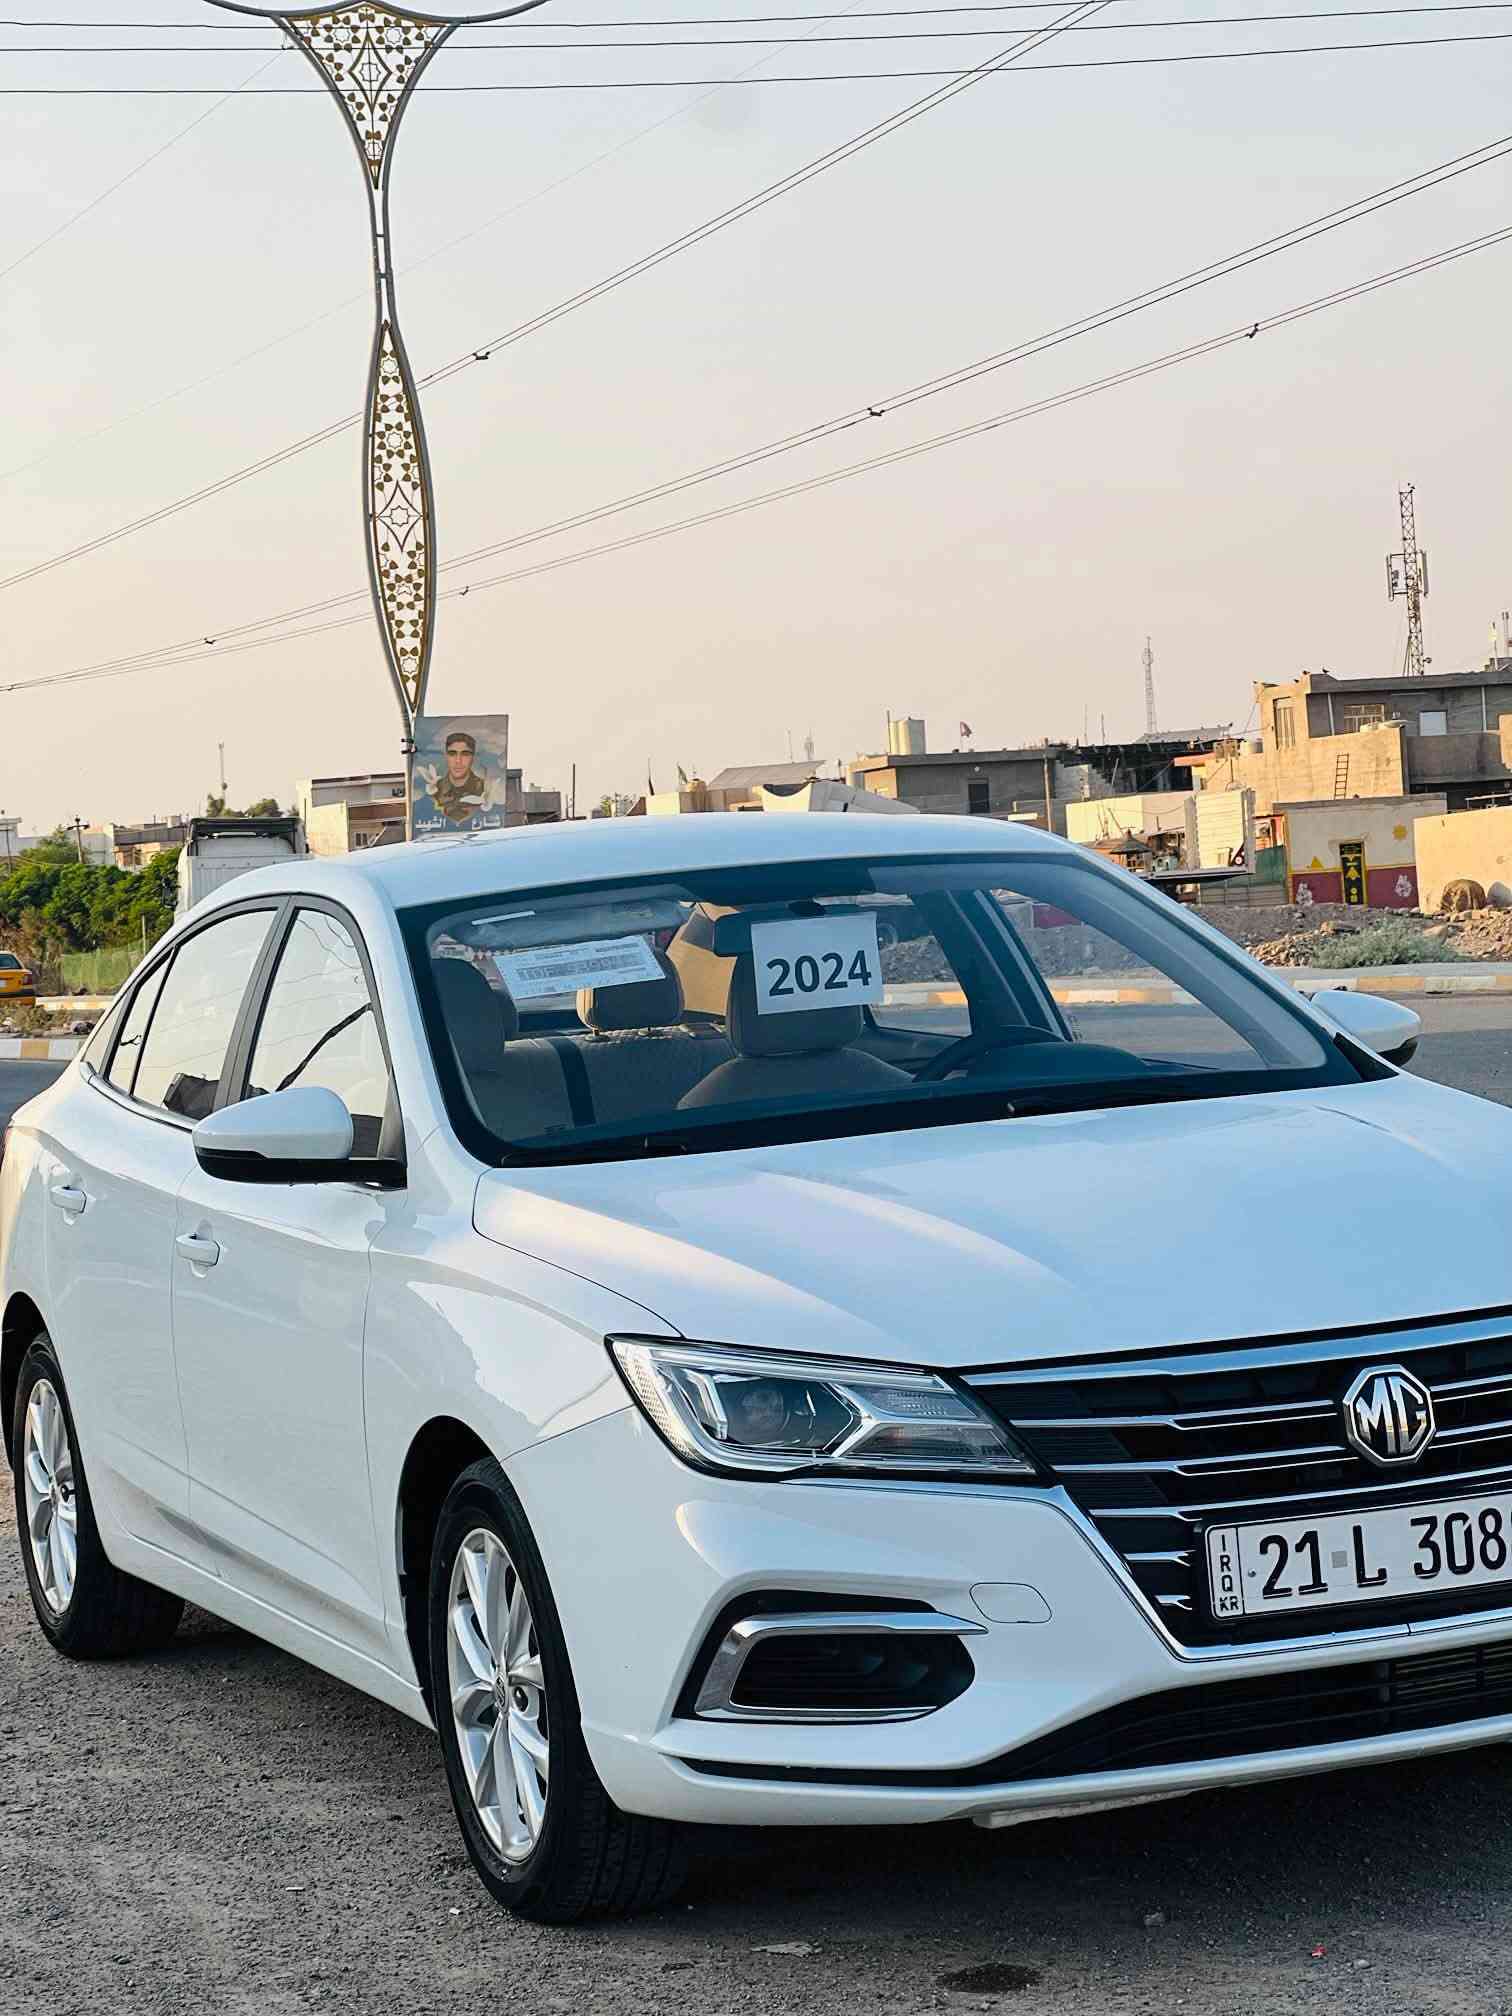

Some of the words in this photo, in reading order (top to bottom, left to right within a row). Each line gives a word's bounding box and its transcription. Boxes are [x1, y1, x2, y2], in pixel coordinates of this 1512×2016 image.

[766, 950, 872, 997] 2024
[1354, 1374, 1428, 1457] MG
[1218, 1535, 1234, 1594] IRQ
[1258, 1530, 1329, 1600] 21
[1352, 1524, 1388, 1589] L
[1410, 1507, 1512, 1580] 308
[1218, 1594, 1240, 1612] KR
